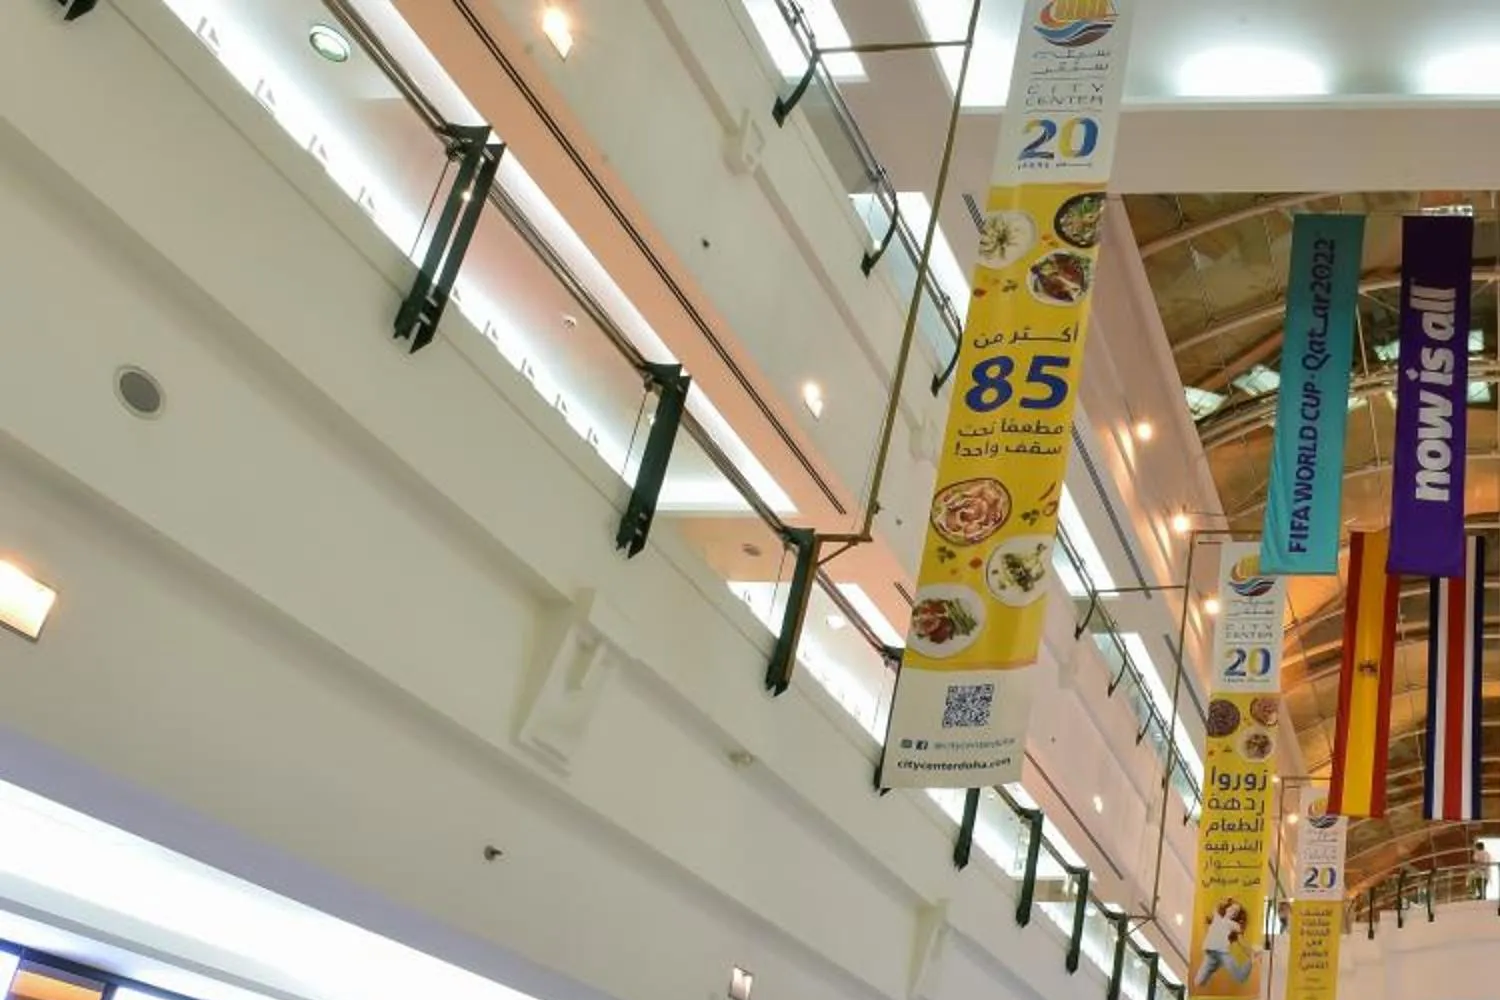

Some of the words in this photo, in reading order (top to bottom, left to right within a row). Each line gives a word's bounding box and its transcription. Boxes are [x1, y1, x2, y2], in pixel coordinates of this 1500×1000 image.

[1018, 117, 1099, 160] 20
[1409, 284, 1457, 341] all
[974, 333, 1004, 349] من
[965, 355, 1071, 412] 85
[1406, 347, 1456, 386] is
[1300, 381, 1323, 421] CUP
[1005, 440, 1062, 455] سقف
[1294, 425, 1319, 502] WORLD
[1414, 390, 1453, 502] now
[1288, 506, 1312, 553] FIFA
[1224, 647, 1271, 677] 20
[1211, 765, 1268, 792] زوروا
[1205, 817, 1265, 837] الطعام
[1303, 866, 1337, 889] 20
